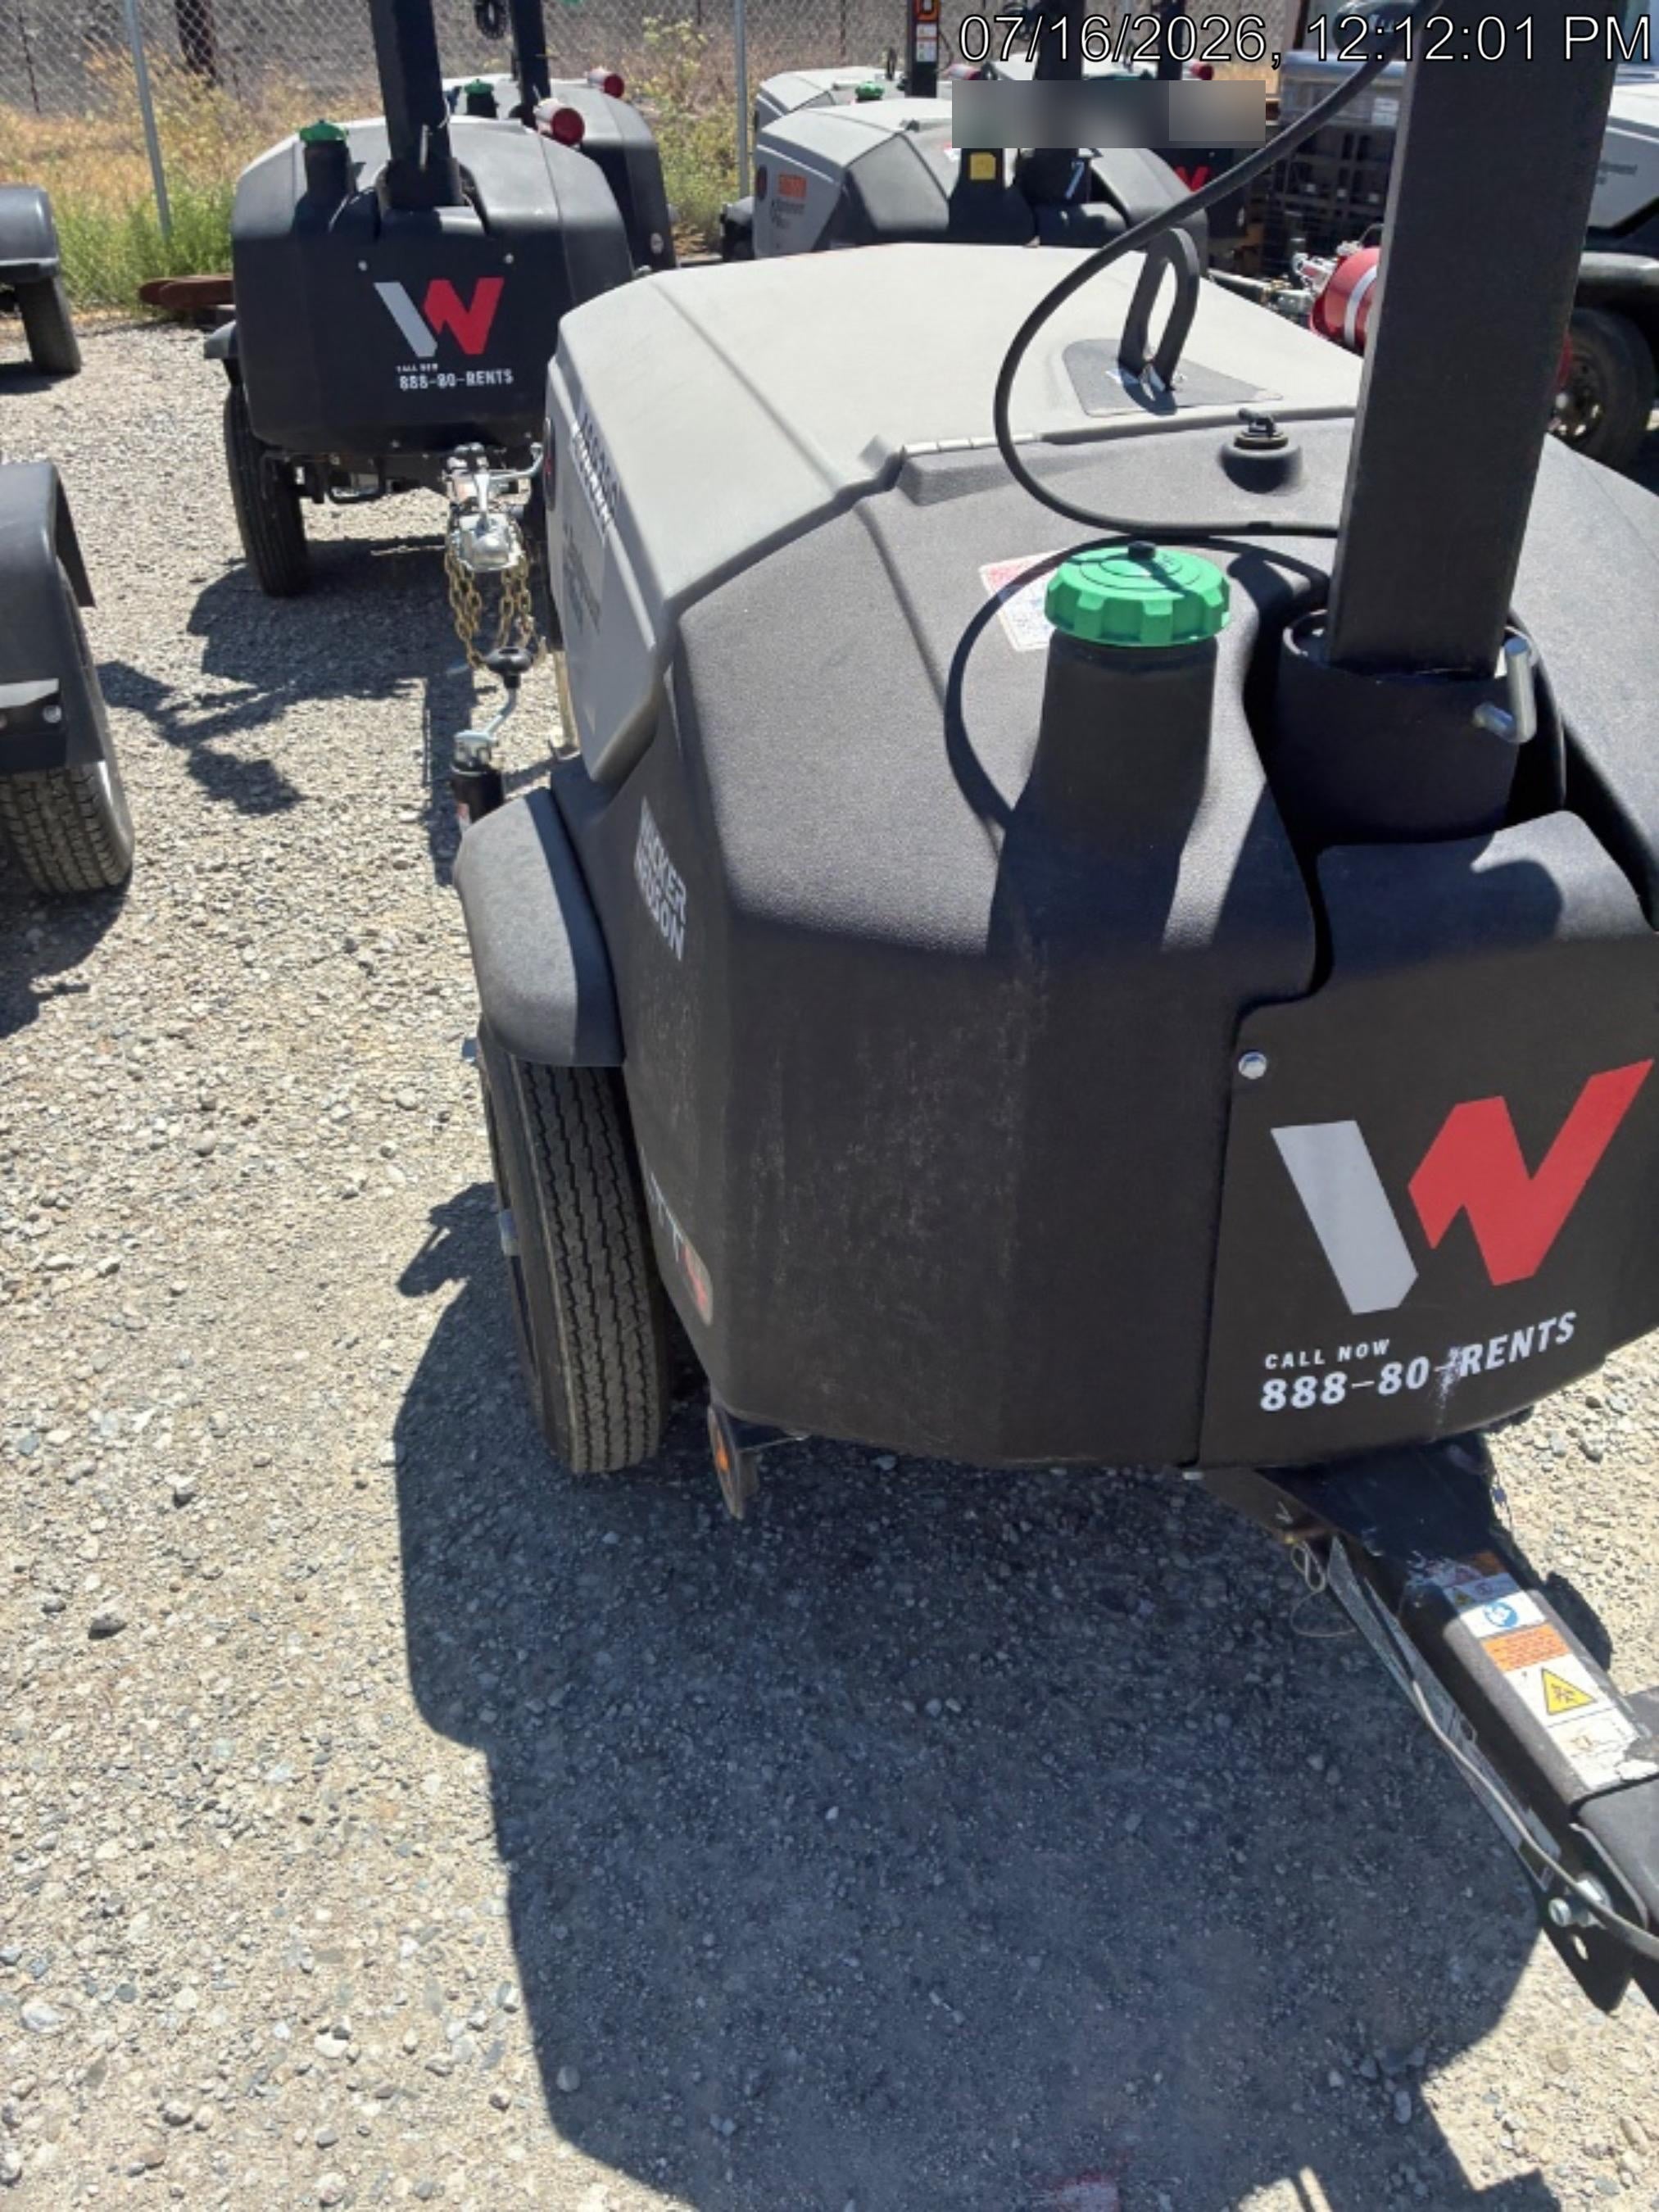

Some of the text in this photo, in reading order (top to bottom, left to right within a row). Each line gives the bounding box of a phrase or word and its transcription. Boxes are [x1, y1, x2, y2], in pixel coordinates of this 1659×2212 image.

[1259, 1311, 1577, 1412] 888-80-RENTS
[1264, 1338, 1391, 1370] CALL NOW
